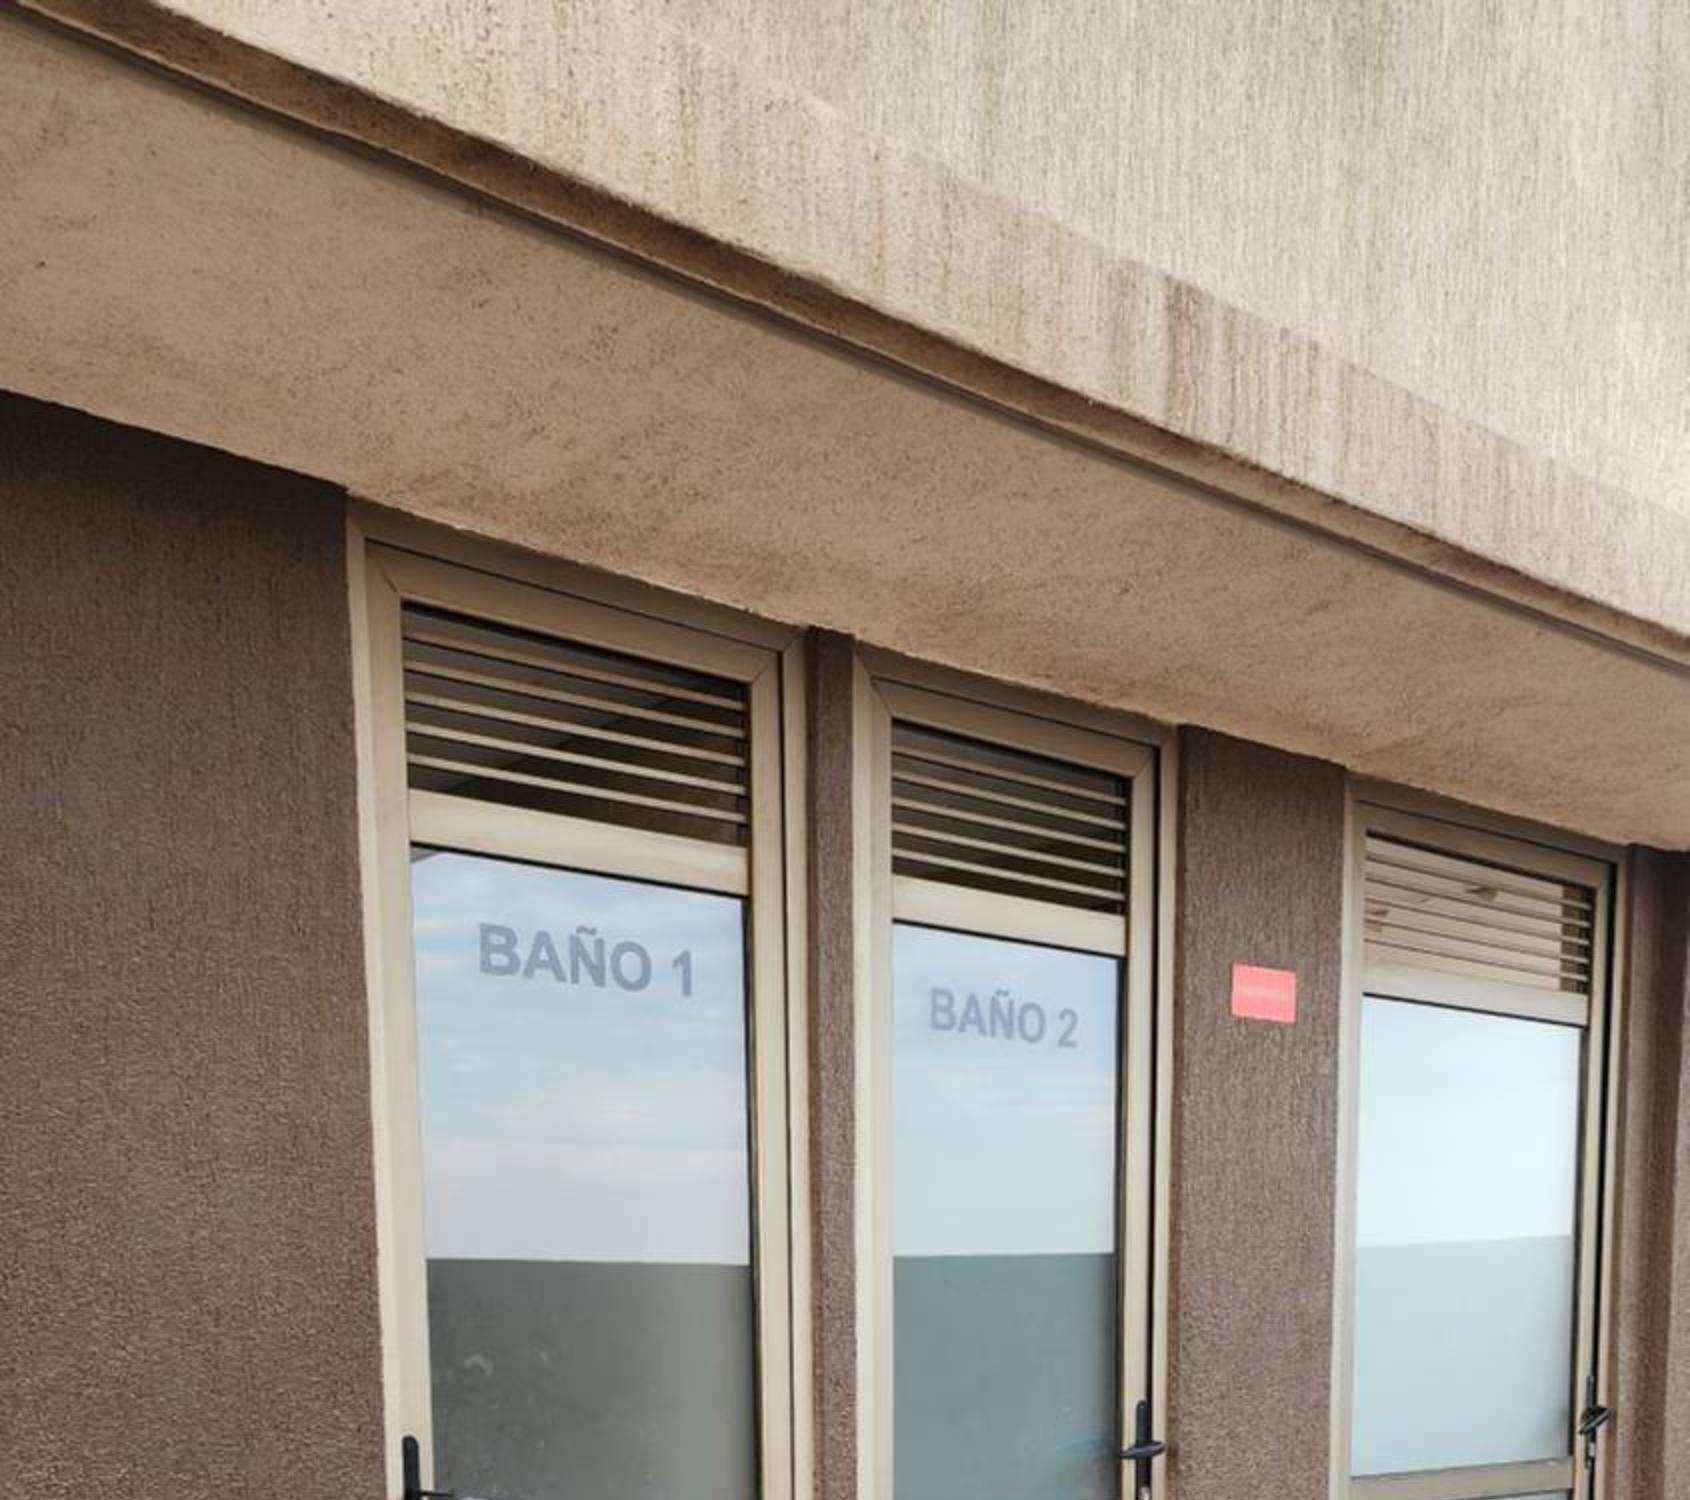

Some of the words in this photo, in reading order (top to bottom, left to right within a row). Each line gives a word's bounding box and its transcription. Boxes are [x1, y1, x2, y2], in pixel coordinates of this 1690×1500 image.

[479, 923, 652, 992] BAÑO
[672, 950, 692, 998] 1
[930, 987, 1046, 1044] BAÑO
[1057, 1008, 1079, 1048] 2
